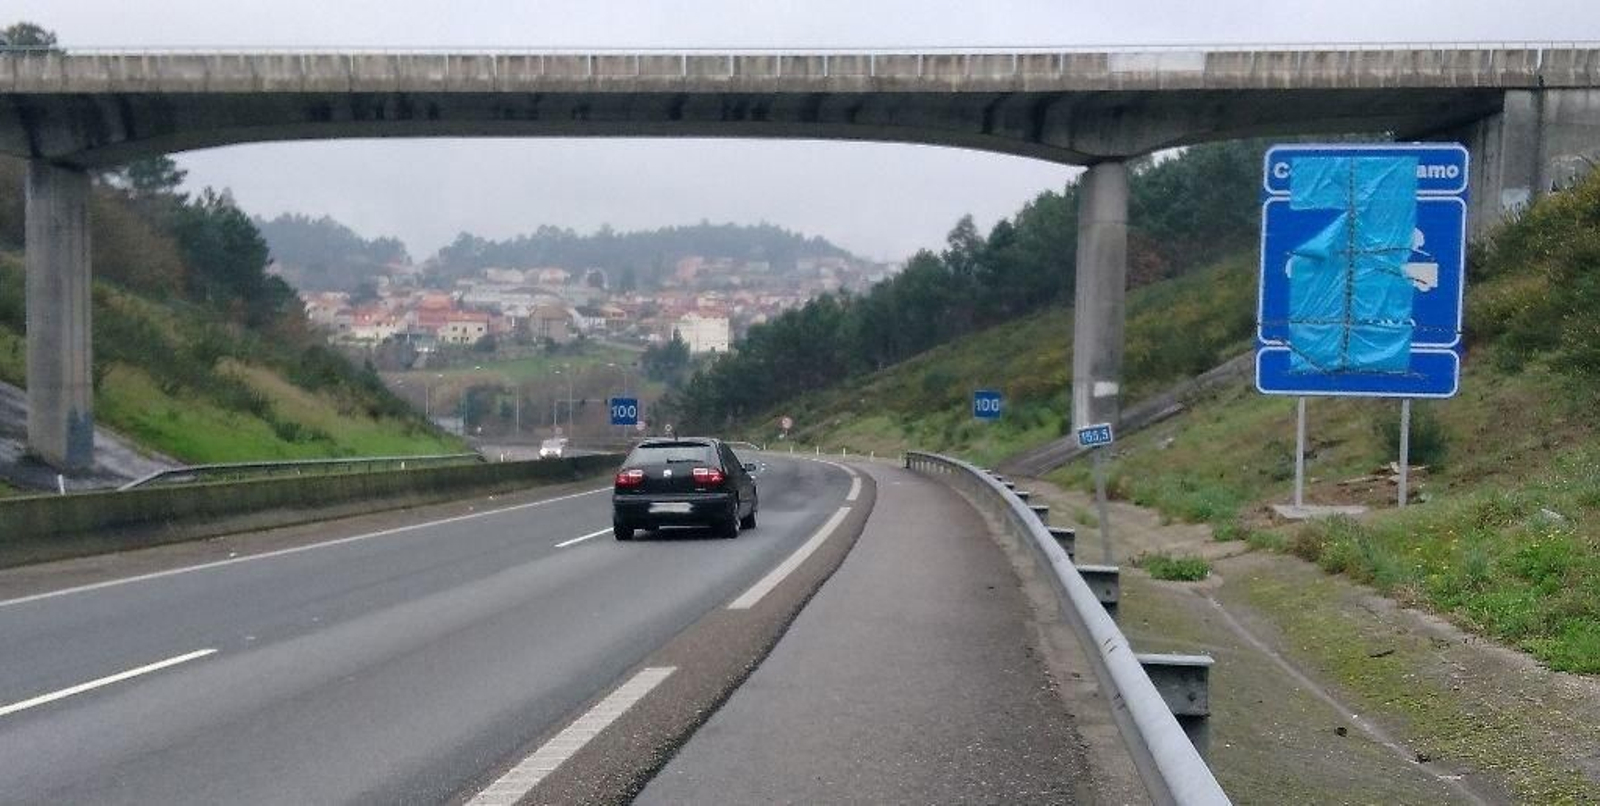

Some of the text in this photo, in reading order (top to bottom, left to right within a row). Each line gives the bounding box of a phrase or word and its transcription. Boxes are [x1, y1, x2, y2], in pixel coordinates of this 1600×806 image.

[1415, 165, 1460, 179] amo
[611, 405, 636, 418] 100
[975, 399, 999, 412] 100
